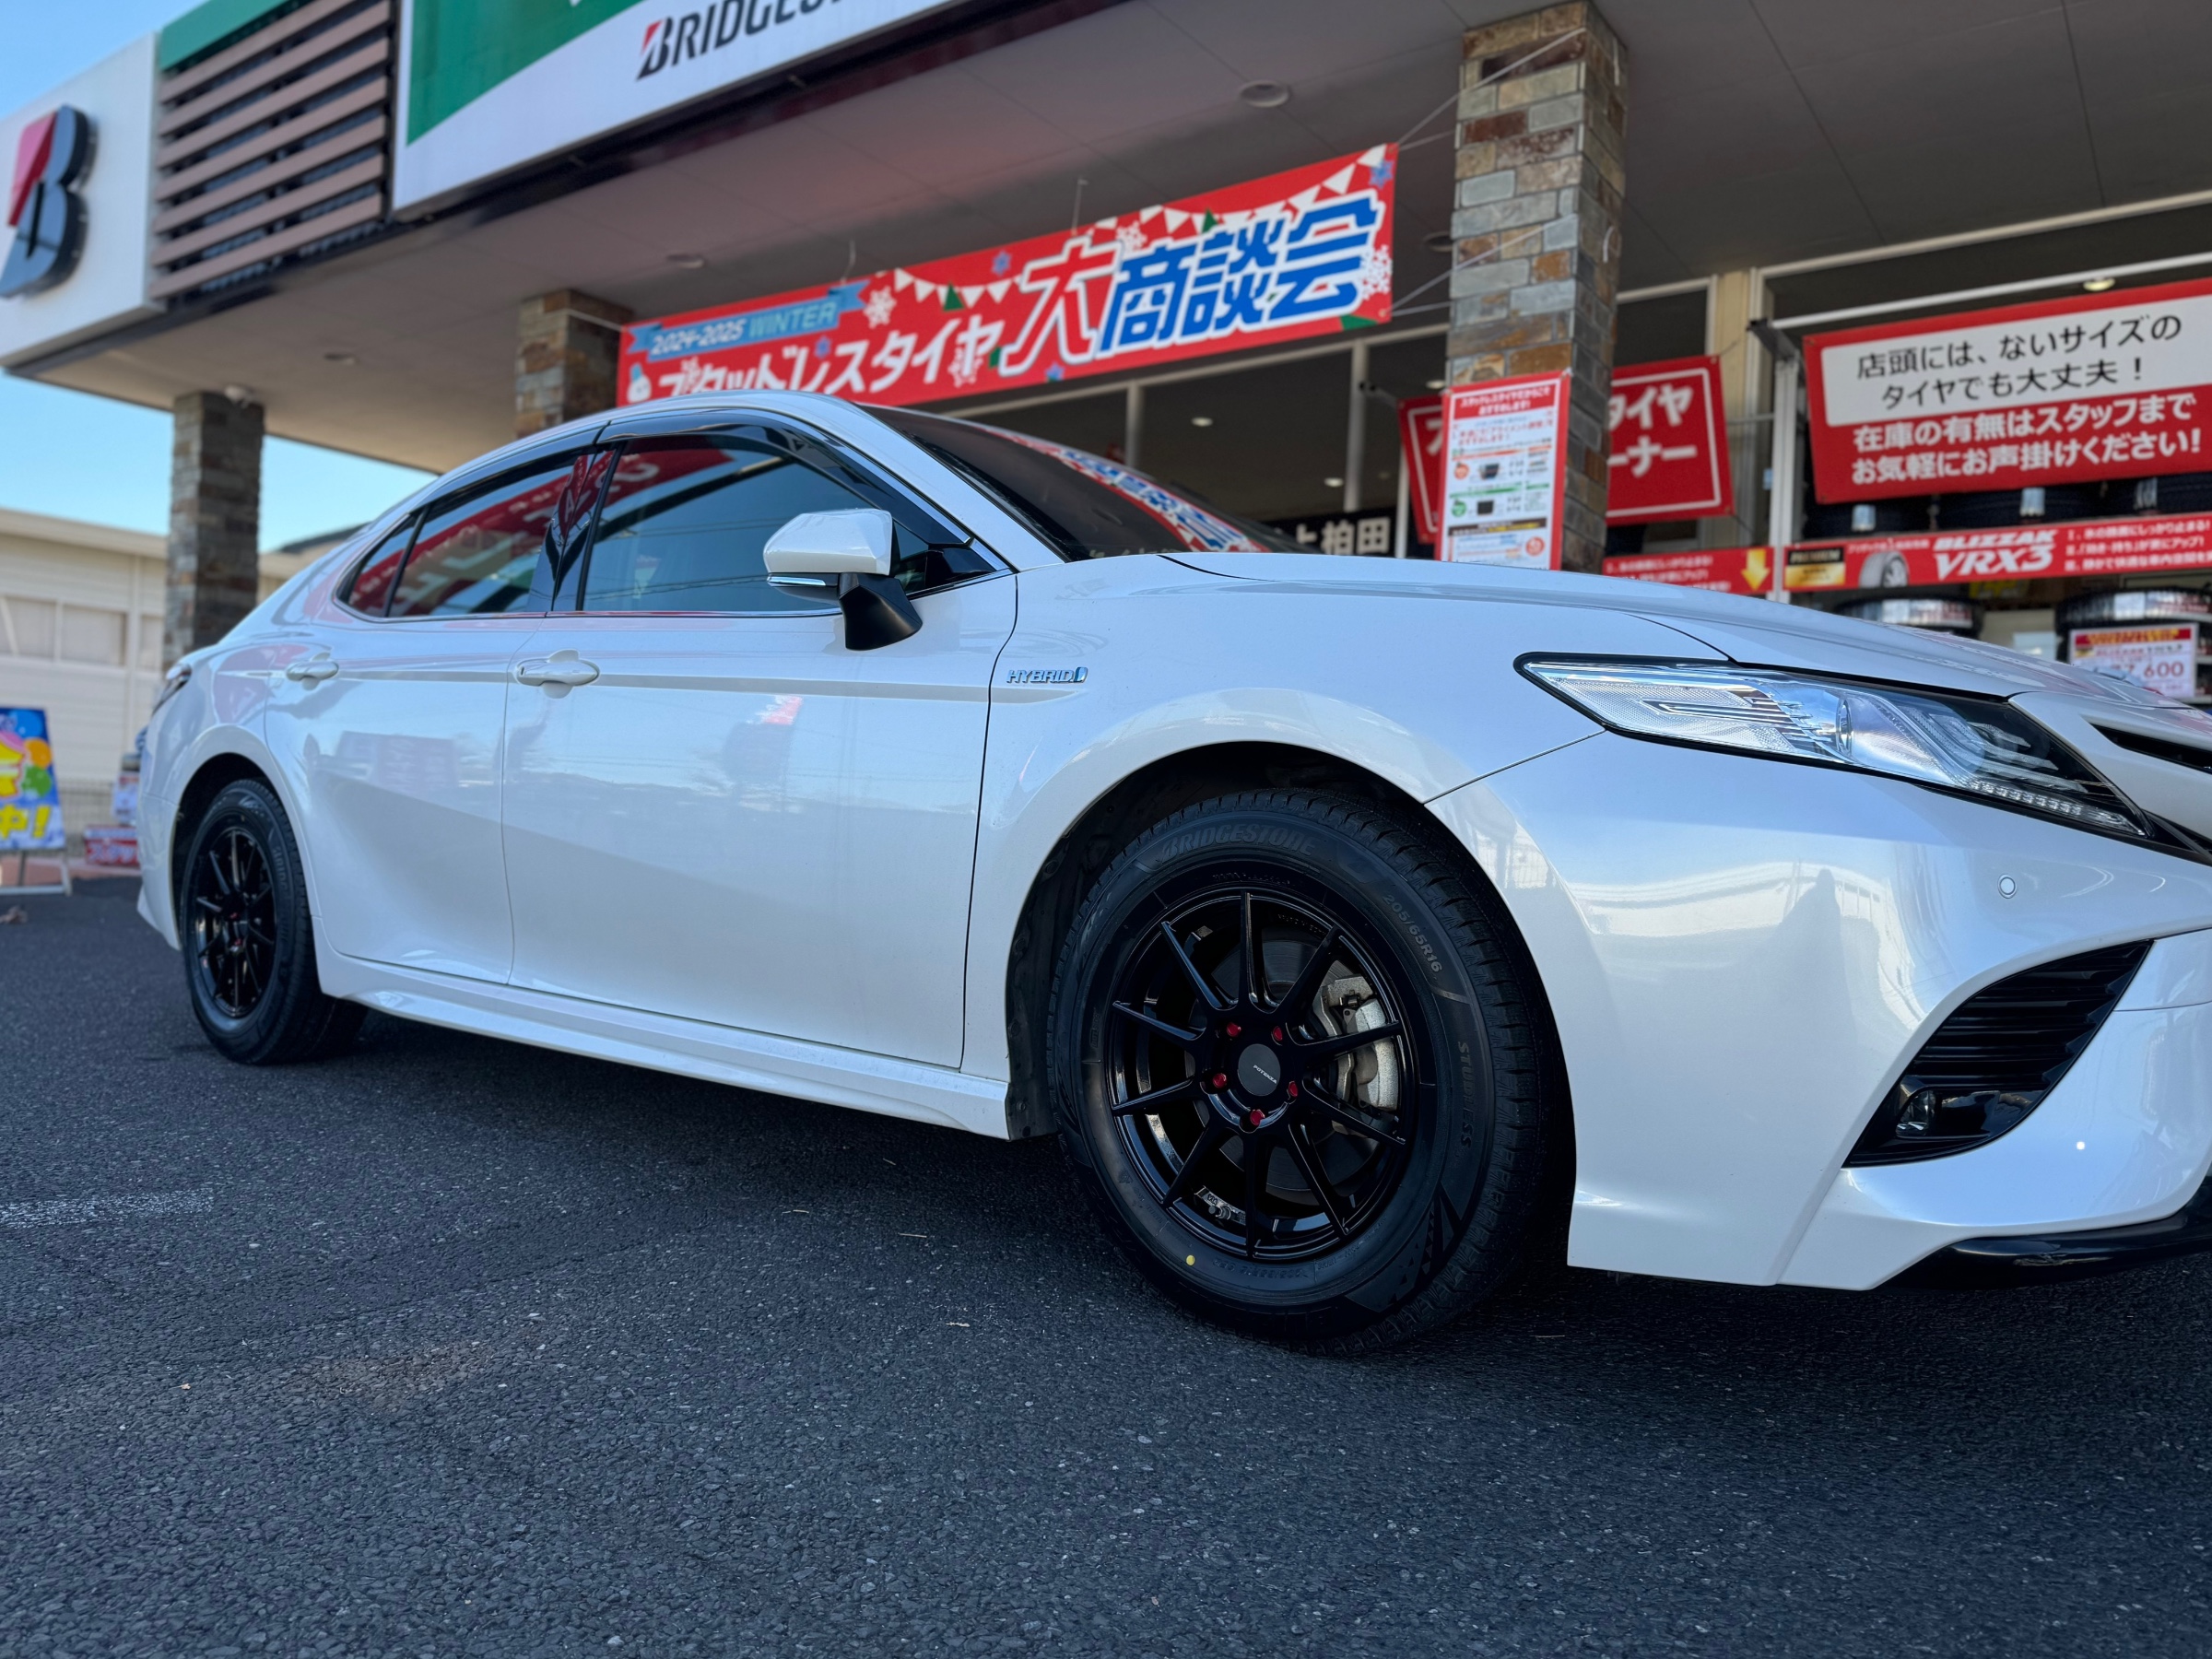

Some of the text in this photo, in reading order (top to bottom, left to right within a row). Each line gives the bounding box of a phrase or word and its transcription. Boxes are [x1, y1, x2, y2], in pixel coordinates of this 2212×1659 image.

[637, 0, 839, 81] BRIDG
[998, 188, 1385, 378] 大商談会
[651, 300, 838, 357] 2024-2025 WINTER
[1856, 314, 2183, 381] 店頭には、ないサイズの
[1853, 392, 2198, 453] 在庫の有無はスタッフまで
[1852, 427, 2202, 486] お気軽にお声掛けください!
[1934, 529, 2059, 551] BLIZZAK
[1935, 545, 2055, 582] VRX3
[1006, 668, 1076, 684] HYBRID
[1156, 822, 1317, 864] BRIDGESTONE
[1382, 894, 1443, 972] 205/65R16
[1457, 1041, 1476, 1149] STUDLESS
